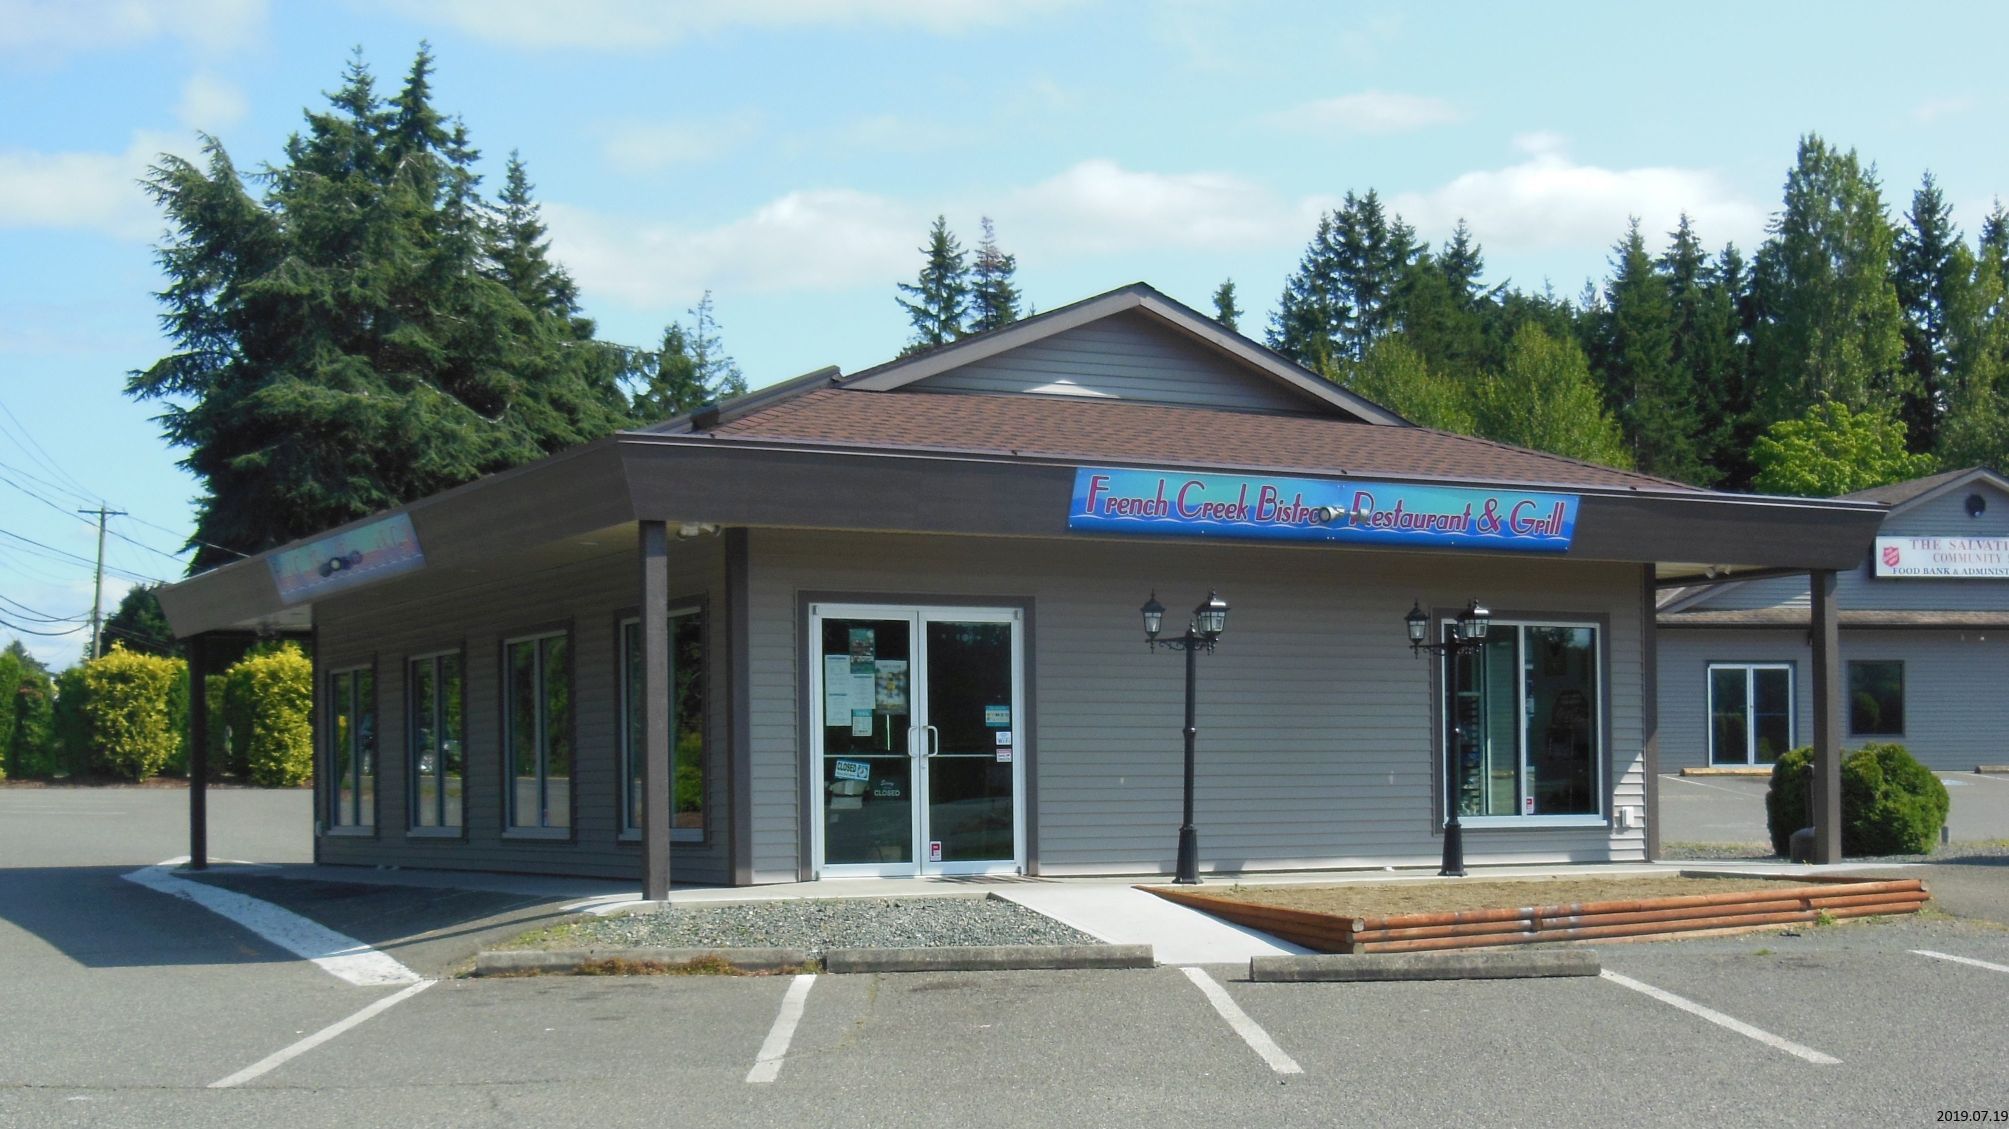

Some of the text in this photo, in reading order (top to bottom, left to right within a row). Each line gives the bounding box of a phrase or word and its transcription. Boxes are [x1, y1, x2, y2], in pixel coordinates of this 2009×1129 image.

[1085, 475, 1168, 517] French
[1177, 480, 1249, 522] Creek
[1349, 491, 1472, 532] Restaurant
[1476, 498, 1503, 534] &
[1509, 500, 1566, 537] Grill
[1909, 539, 1942, 550] THE
[1933, 553, 2002, 563] COMMUNITY
[1892, 567, 1921, 575] FOOD
[1923, 567, 1950, 575] BANK
[837, 761, 857, 773] CLOSED
